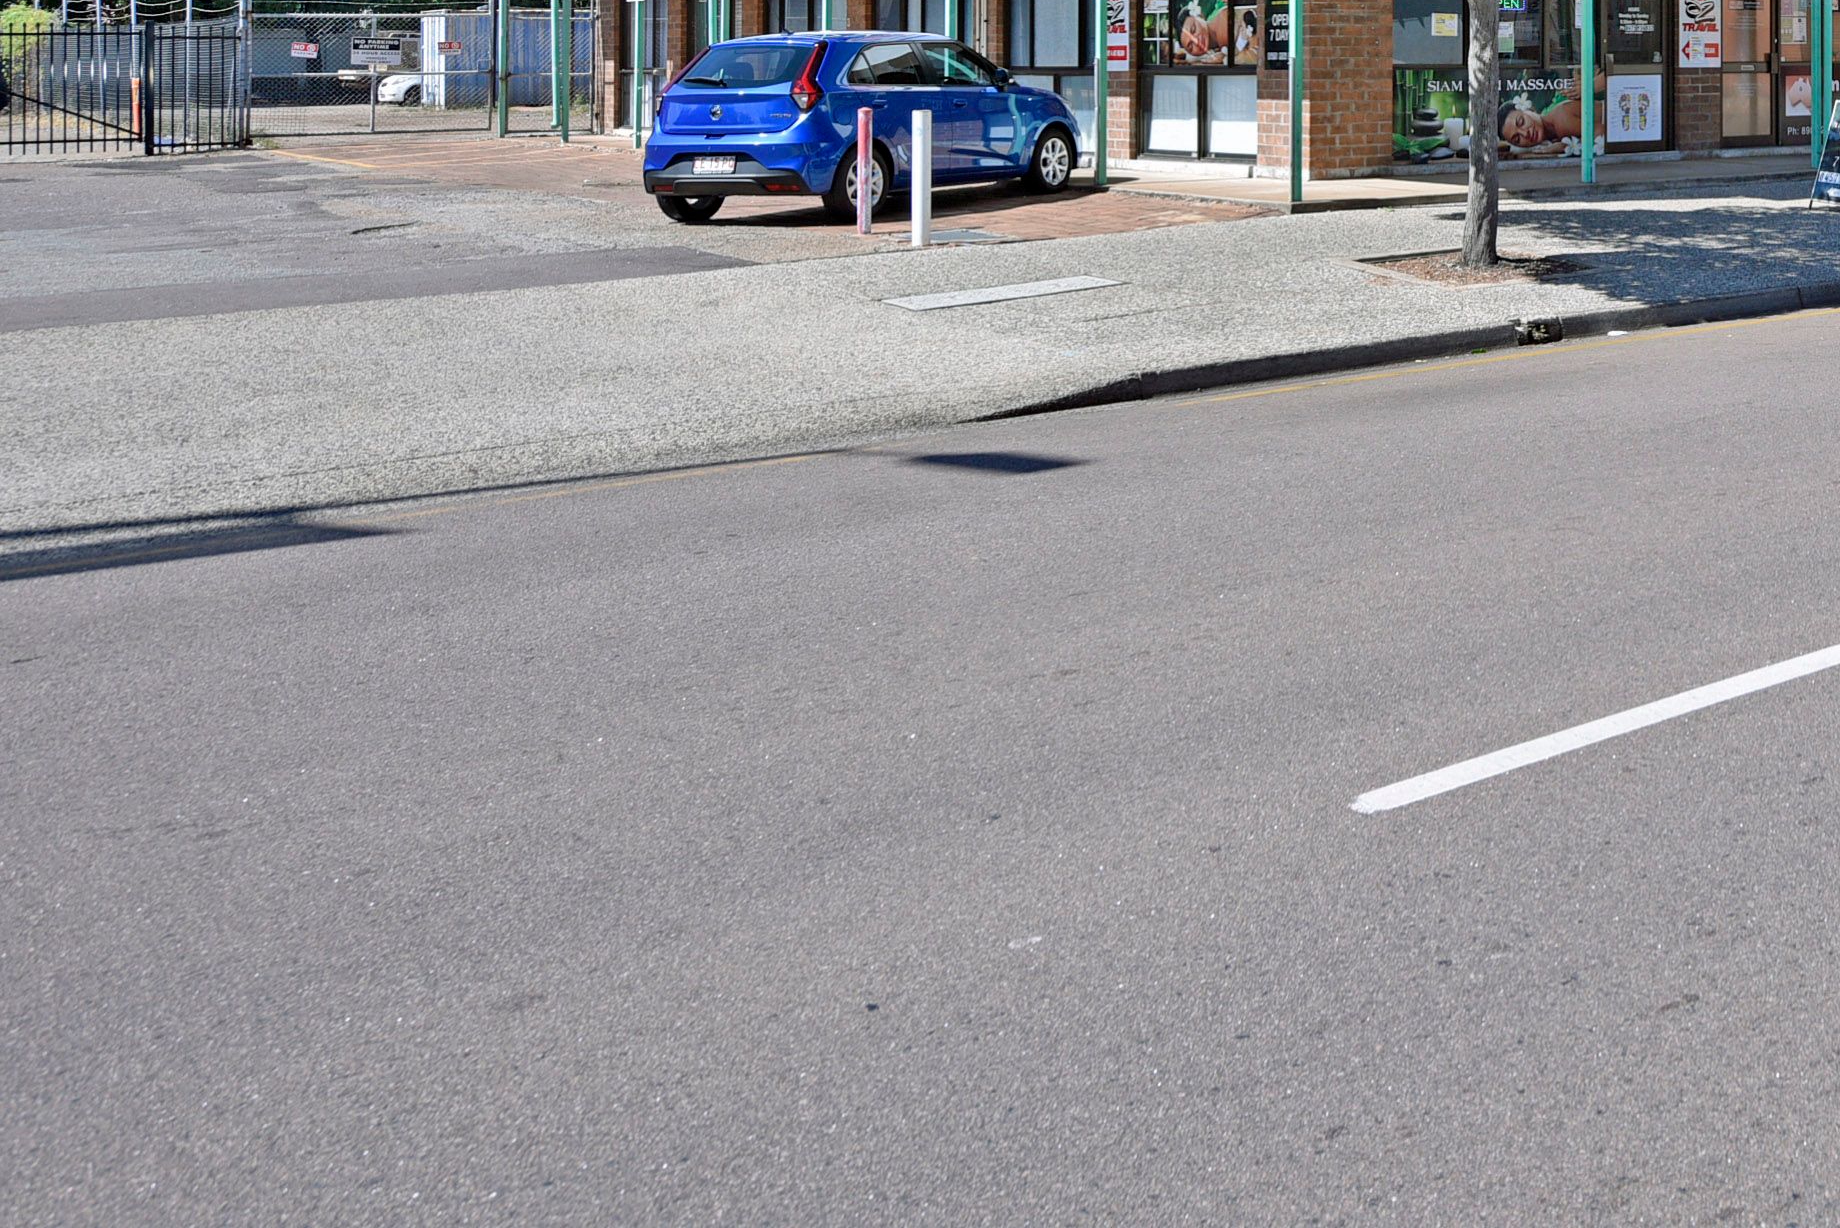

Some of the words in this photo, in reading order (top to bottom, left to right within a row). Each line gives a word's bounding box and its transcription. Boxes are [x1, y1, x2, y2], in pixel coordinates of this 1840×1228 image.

[1272, 14, 1289, 27] OPE
[1682, 23, 1719, 32] TRAVEL
[1427, 80, 1463, 92] SIAM
[1507, 78, 1573, 91] MASSAGE
[1833, 156, 1839, 168] 7
